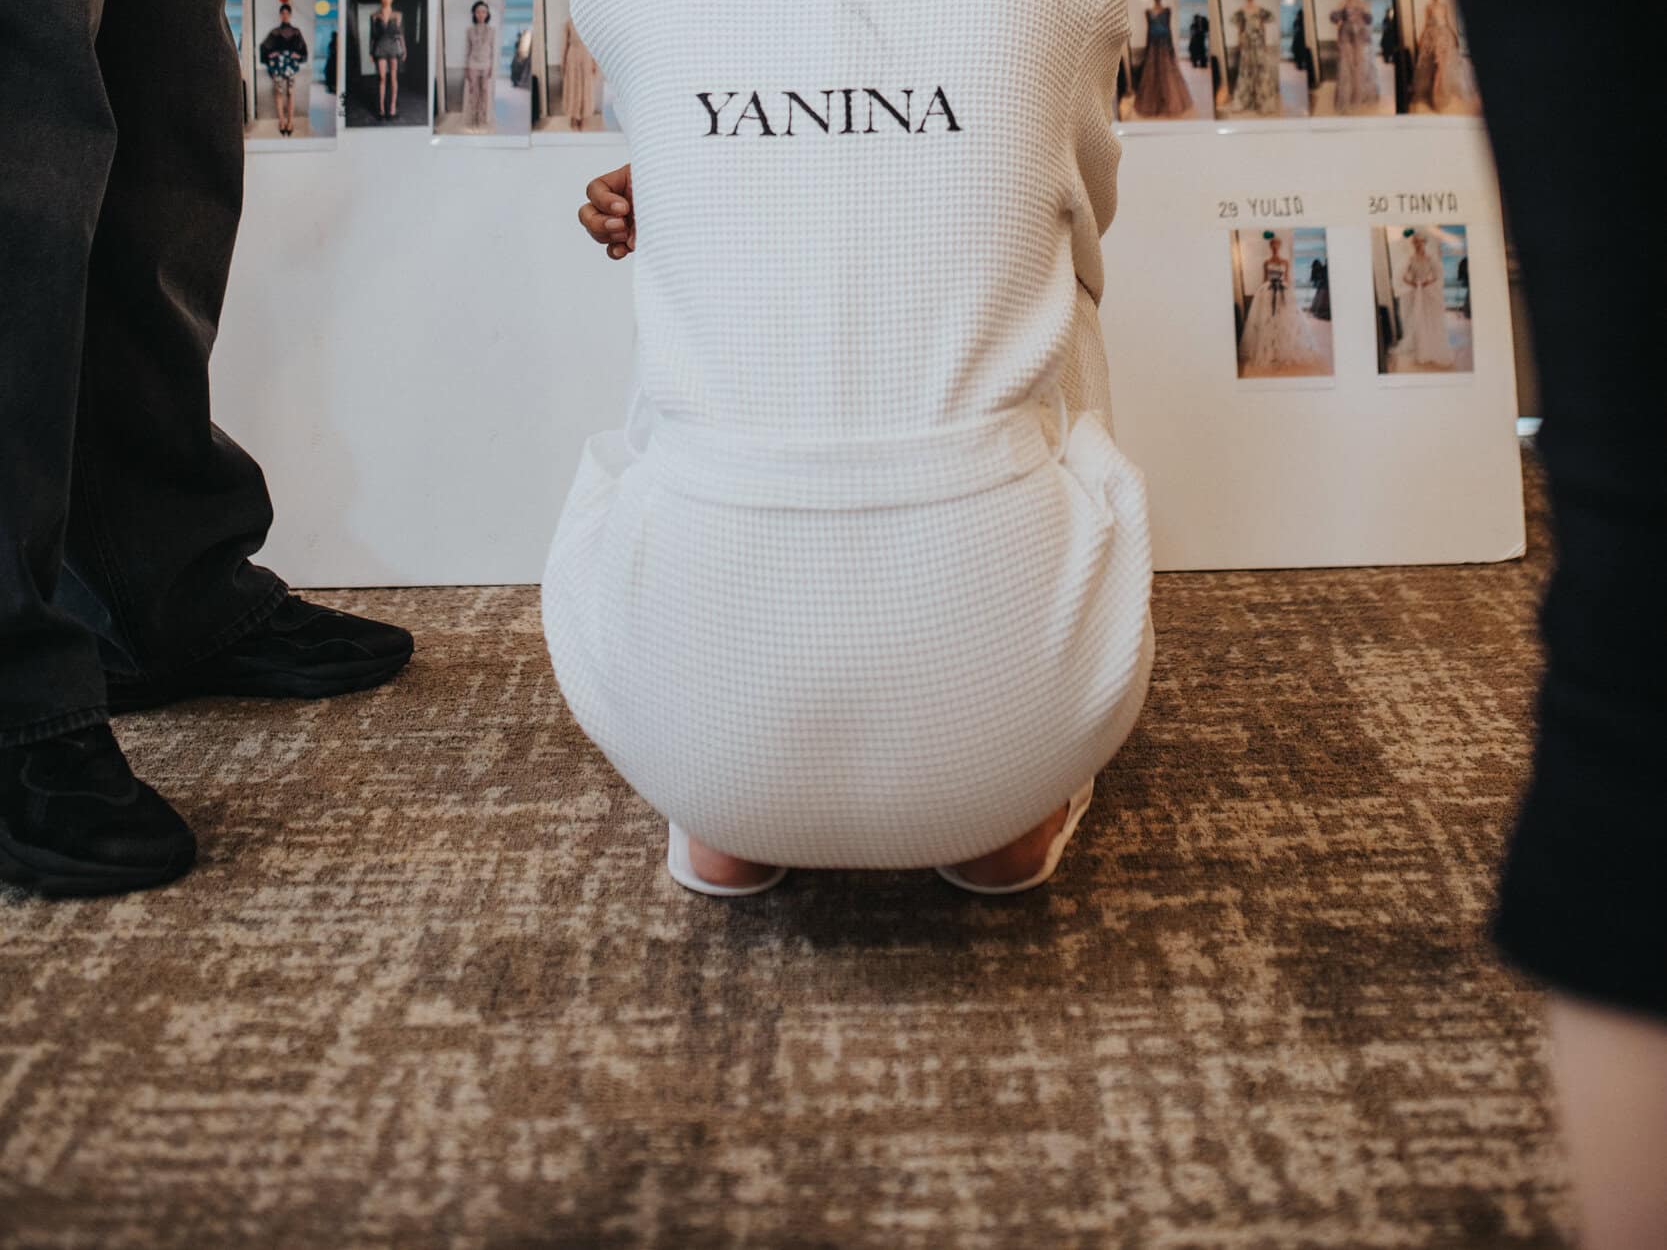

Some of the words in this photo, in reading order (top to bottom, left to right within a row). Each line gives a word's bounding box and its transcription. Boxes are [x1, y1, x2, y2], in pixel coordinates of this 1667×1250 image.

[696, 86, 963, 137] YANINA
[1218, 202, 1239, 219] 29
[1247, 195, 1304, 218] YULIA
[1368, 196, 1389, 215] 30
[1397, 192, 1458, 213] TANYA
